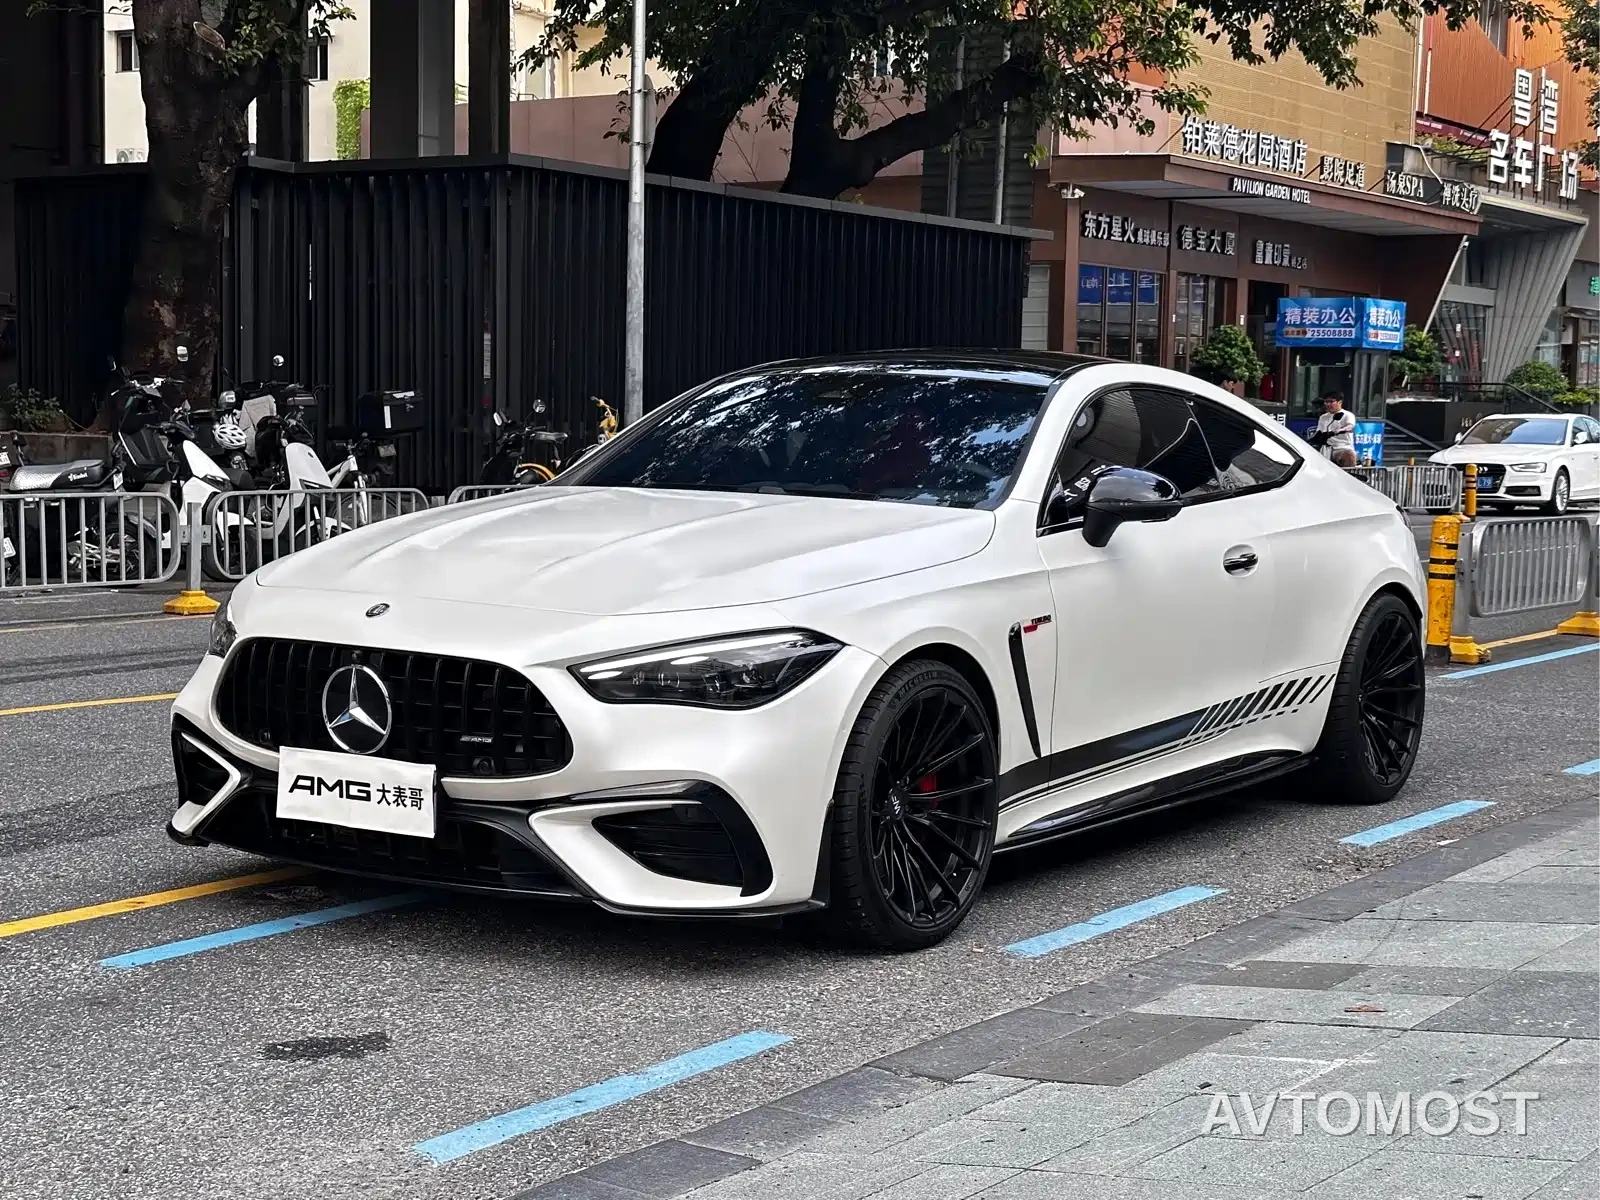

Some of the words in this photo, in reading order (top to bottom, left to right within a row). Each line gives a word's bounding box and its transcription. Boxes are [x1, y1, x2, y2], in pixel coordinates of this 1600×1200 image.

[1489, 128, 1578, 200] 名车广场
[1232, 177, 1264, 196] PAVILION
[1264, 183, 1291, 200] GARDEN
[1291, 188, 1311, 204] HOTEL
[1084, 210, 1135, 243] 东方星火
[1181, 226, 1235, 256] 德宝大厦
[1285, 307, 1355, 325] 精装办公
[1369, 306, 1401, 328] 精装办公
[1310, 329, 1353, 337] 25508888
[288, 775, 371, 802] AMG
[376, 783, 424, 811] 大表哥
